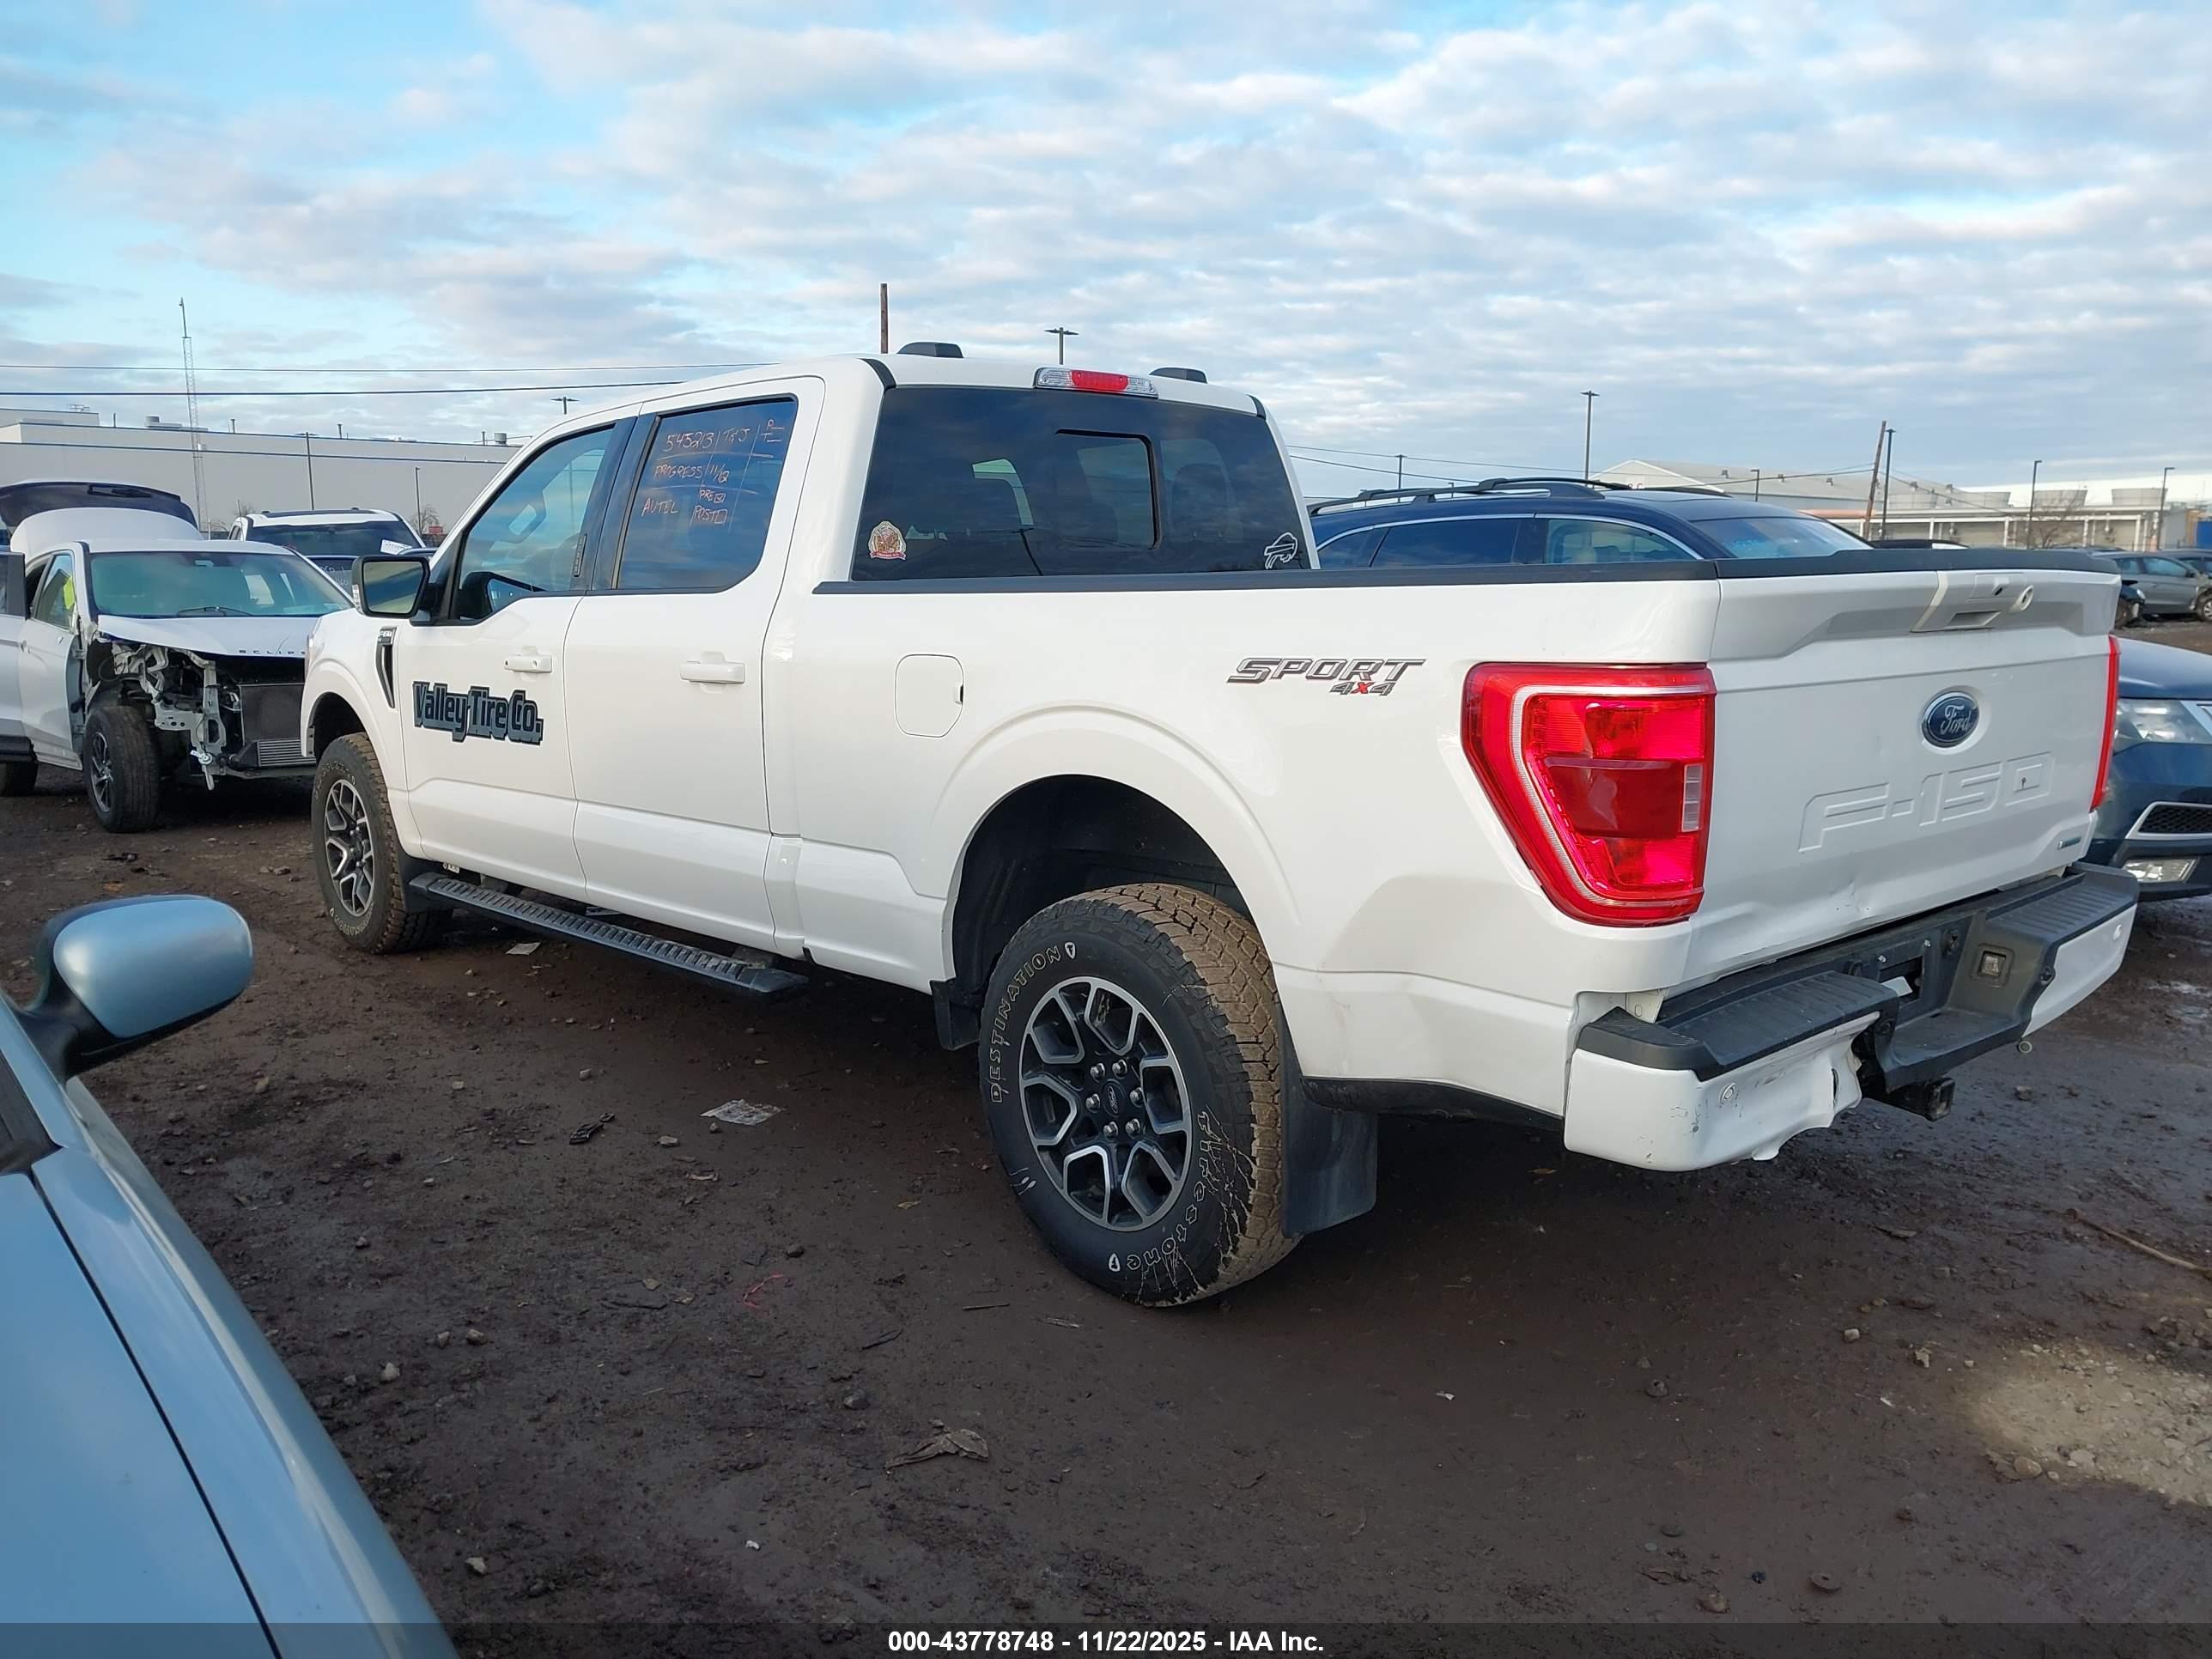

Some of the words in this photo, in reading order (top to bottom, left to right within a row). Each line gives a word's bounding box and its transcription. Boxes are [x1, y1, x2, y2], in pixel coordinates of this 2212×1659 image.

[663, 431, 714, 452] 545213
[653, 465, 702, 480] PROGRESS
[641, 497, 678, 517] AUTEL
[699, 489, 714, 501] PRE
[1227, 657, 1426, 684] SPORT
[413, 682, 468, 742] Valley
[469, 686, 509, 740] Tire
[508, 690, 544, 745] Co.
[1940, 704, 1972, 736] Ford
[1798, 750, 2055, 853] F-150
[990, 945, 1060, 1104] DESTINATION
